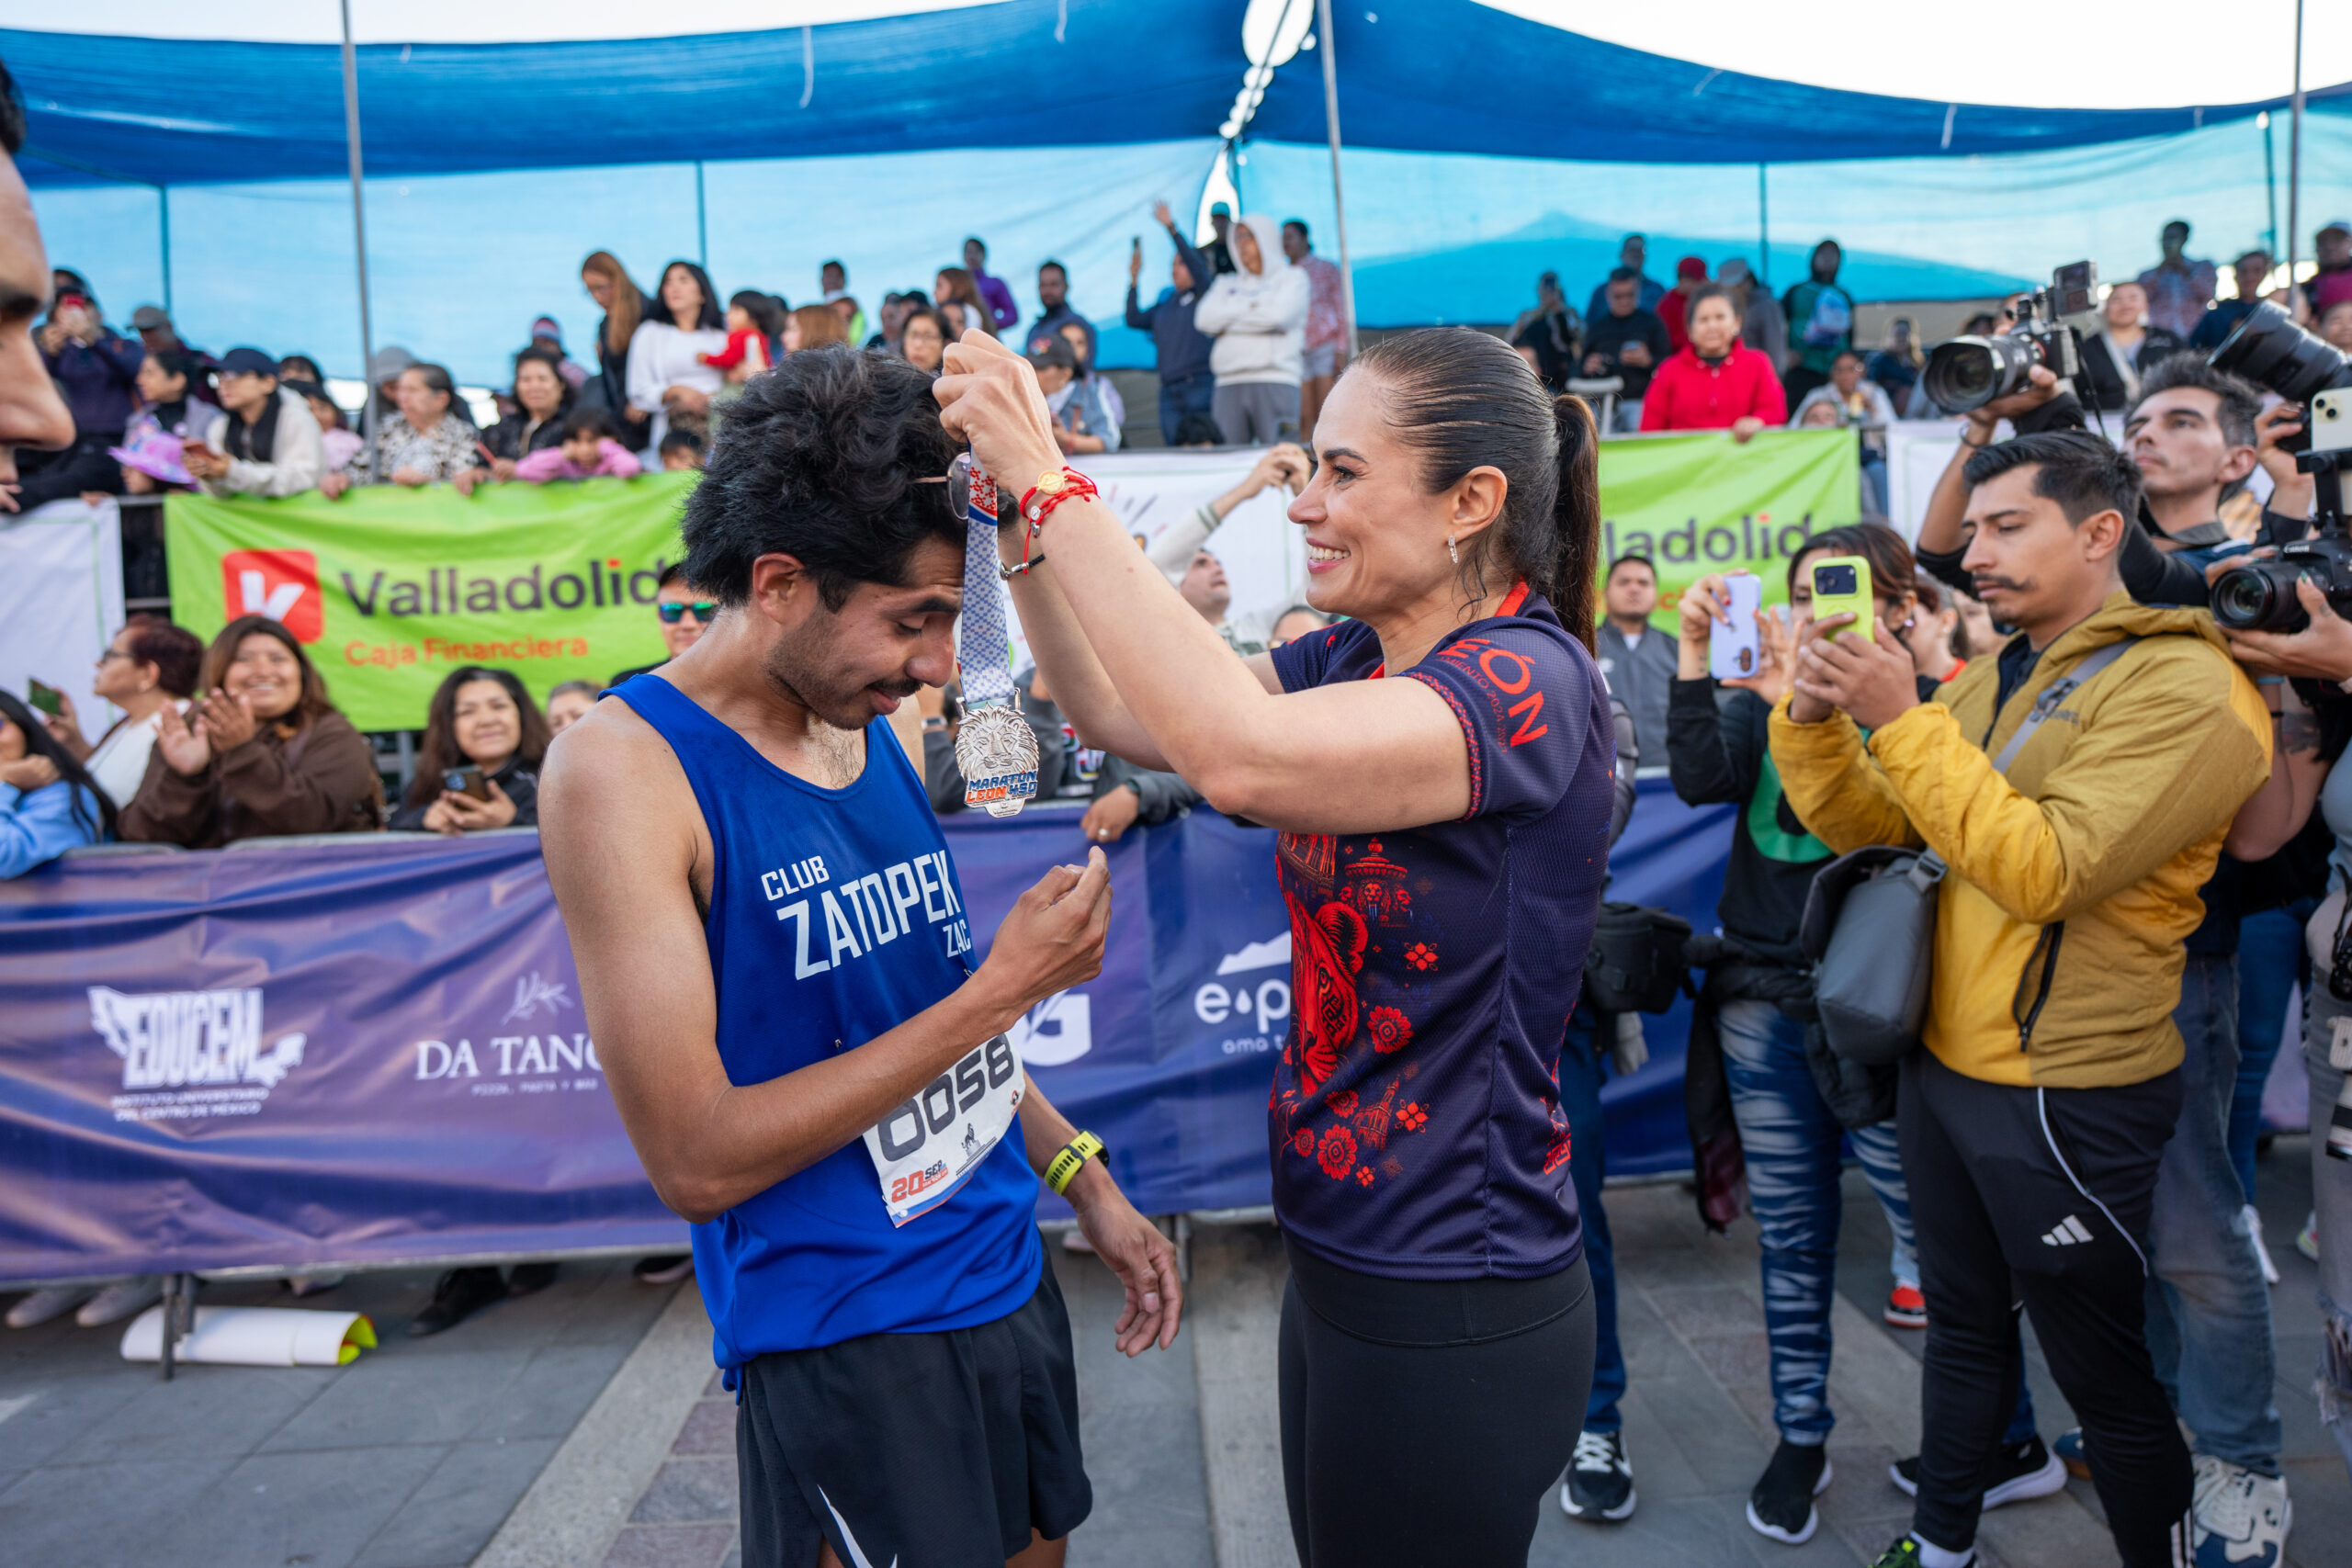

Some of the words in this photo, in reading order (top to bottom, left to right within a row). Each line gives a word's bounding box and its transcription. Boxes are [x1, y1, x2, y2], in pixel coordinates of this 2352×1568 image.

[341, 558, 667, 617] Valladolid
[345, 639, 416, 669] Caja
[424, 637, 589, 663] Financiera
[761, 855, 830, 901] CLUB
[776, 850, 961, 980] ZATOPEK
[943, 919, 971, 958] ZAC
[123, 988, 263, 1089] EDUCEM
[415, 1038, 480, 1080] DA
[878, 1032, 1014, 1162] 0058
[891, 1170, 924, 1203] 20
[924, 1159, 943, 1180] SEP
